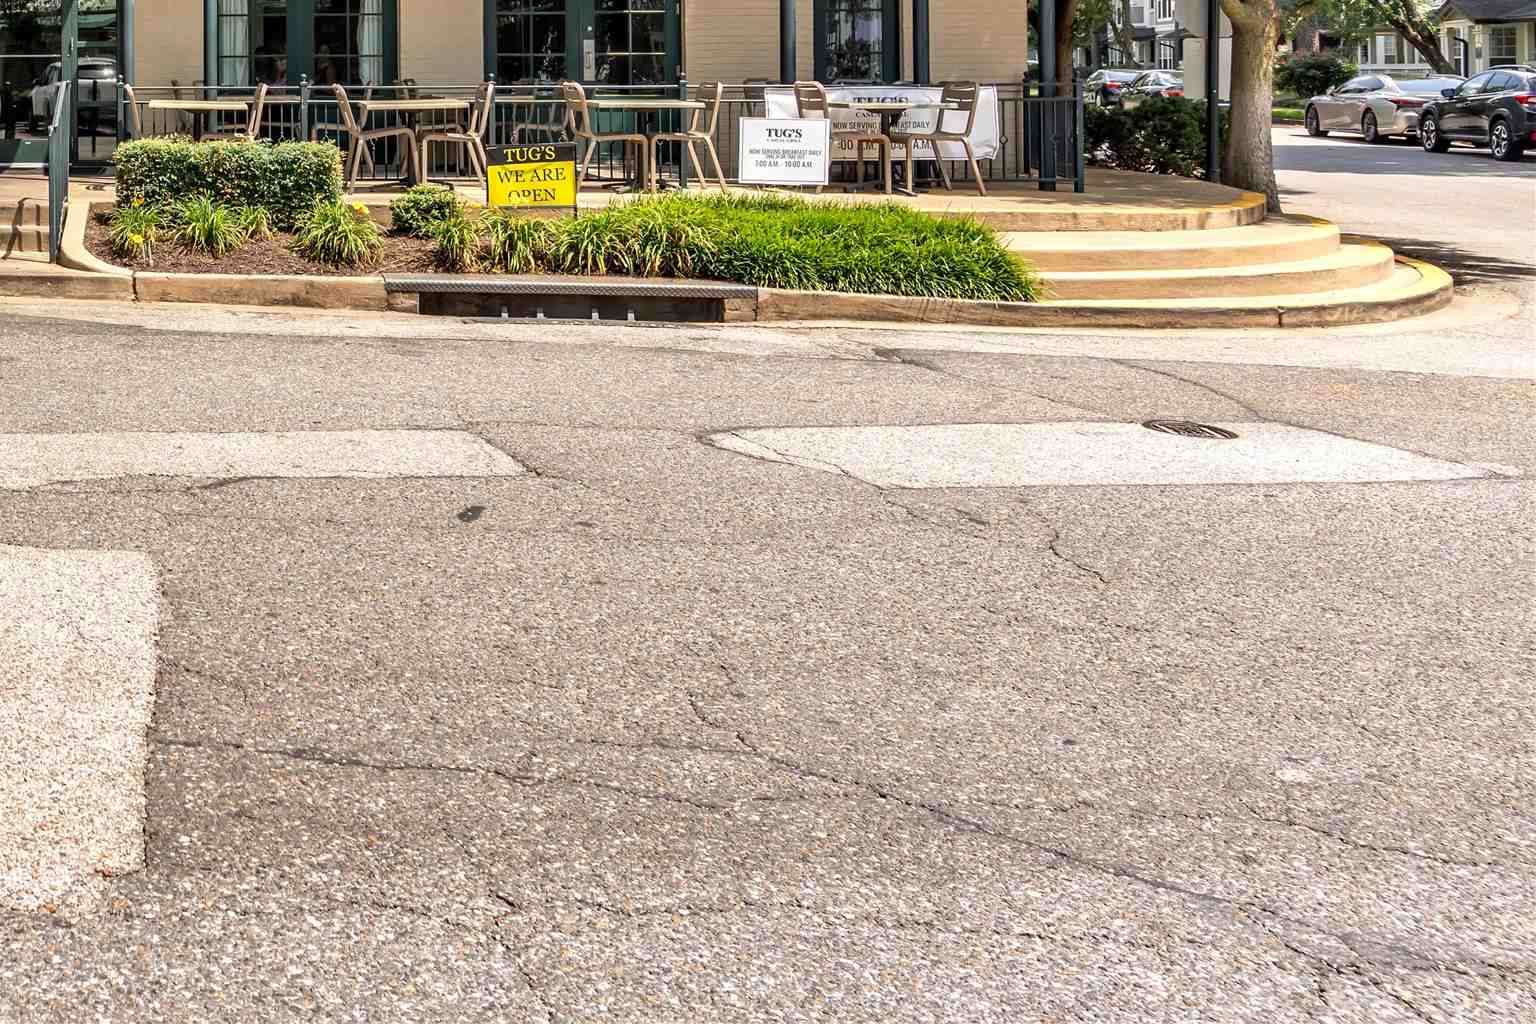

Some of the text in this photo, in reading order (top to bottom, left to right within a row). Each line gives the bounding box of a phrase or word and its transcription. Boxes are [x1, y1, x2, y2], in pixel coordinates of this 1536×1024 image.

[833, 121, 847, 129] NOW
[848, 120, 877, 129] SERVING
[912, 121, 930, 129] DAILY
[765, 128, 803, 138] TUG'S
[504, 145, 556, 162] TUG'S
[497, 167, 566, 184] WE ARE
